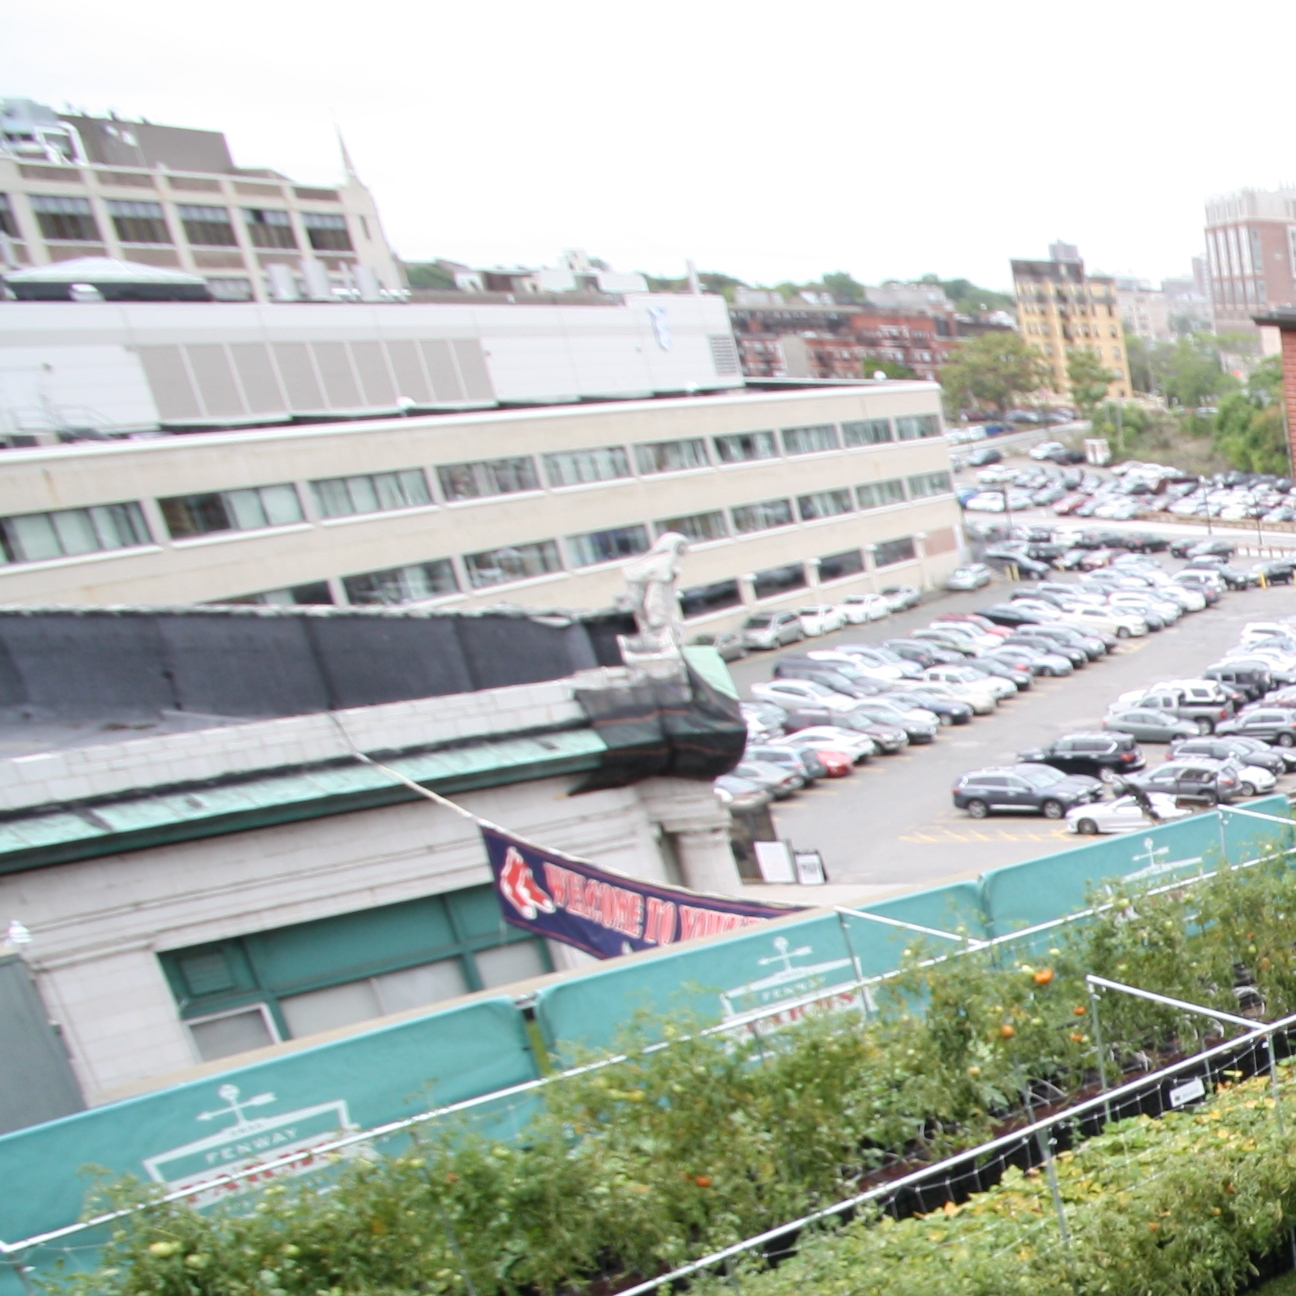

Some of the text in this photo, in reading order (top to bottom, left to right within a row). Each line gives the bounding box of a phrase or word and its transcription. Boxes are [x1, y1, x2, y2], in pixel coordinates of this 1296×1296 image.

[546, 863, 643, 937] WELCOME
[645, 897, 677, 946] TO
[206, 1128, 298, 1164] FENWAY
